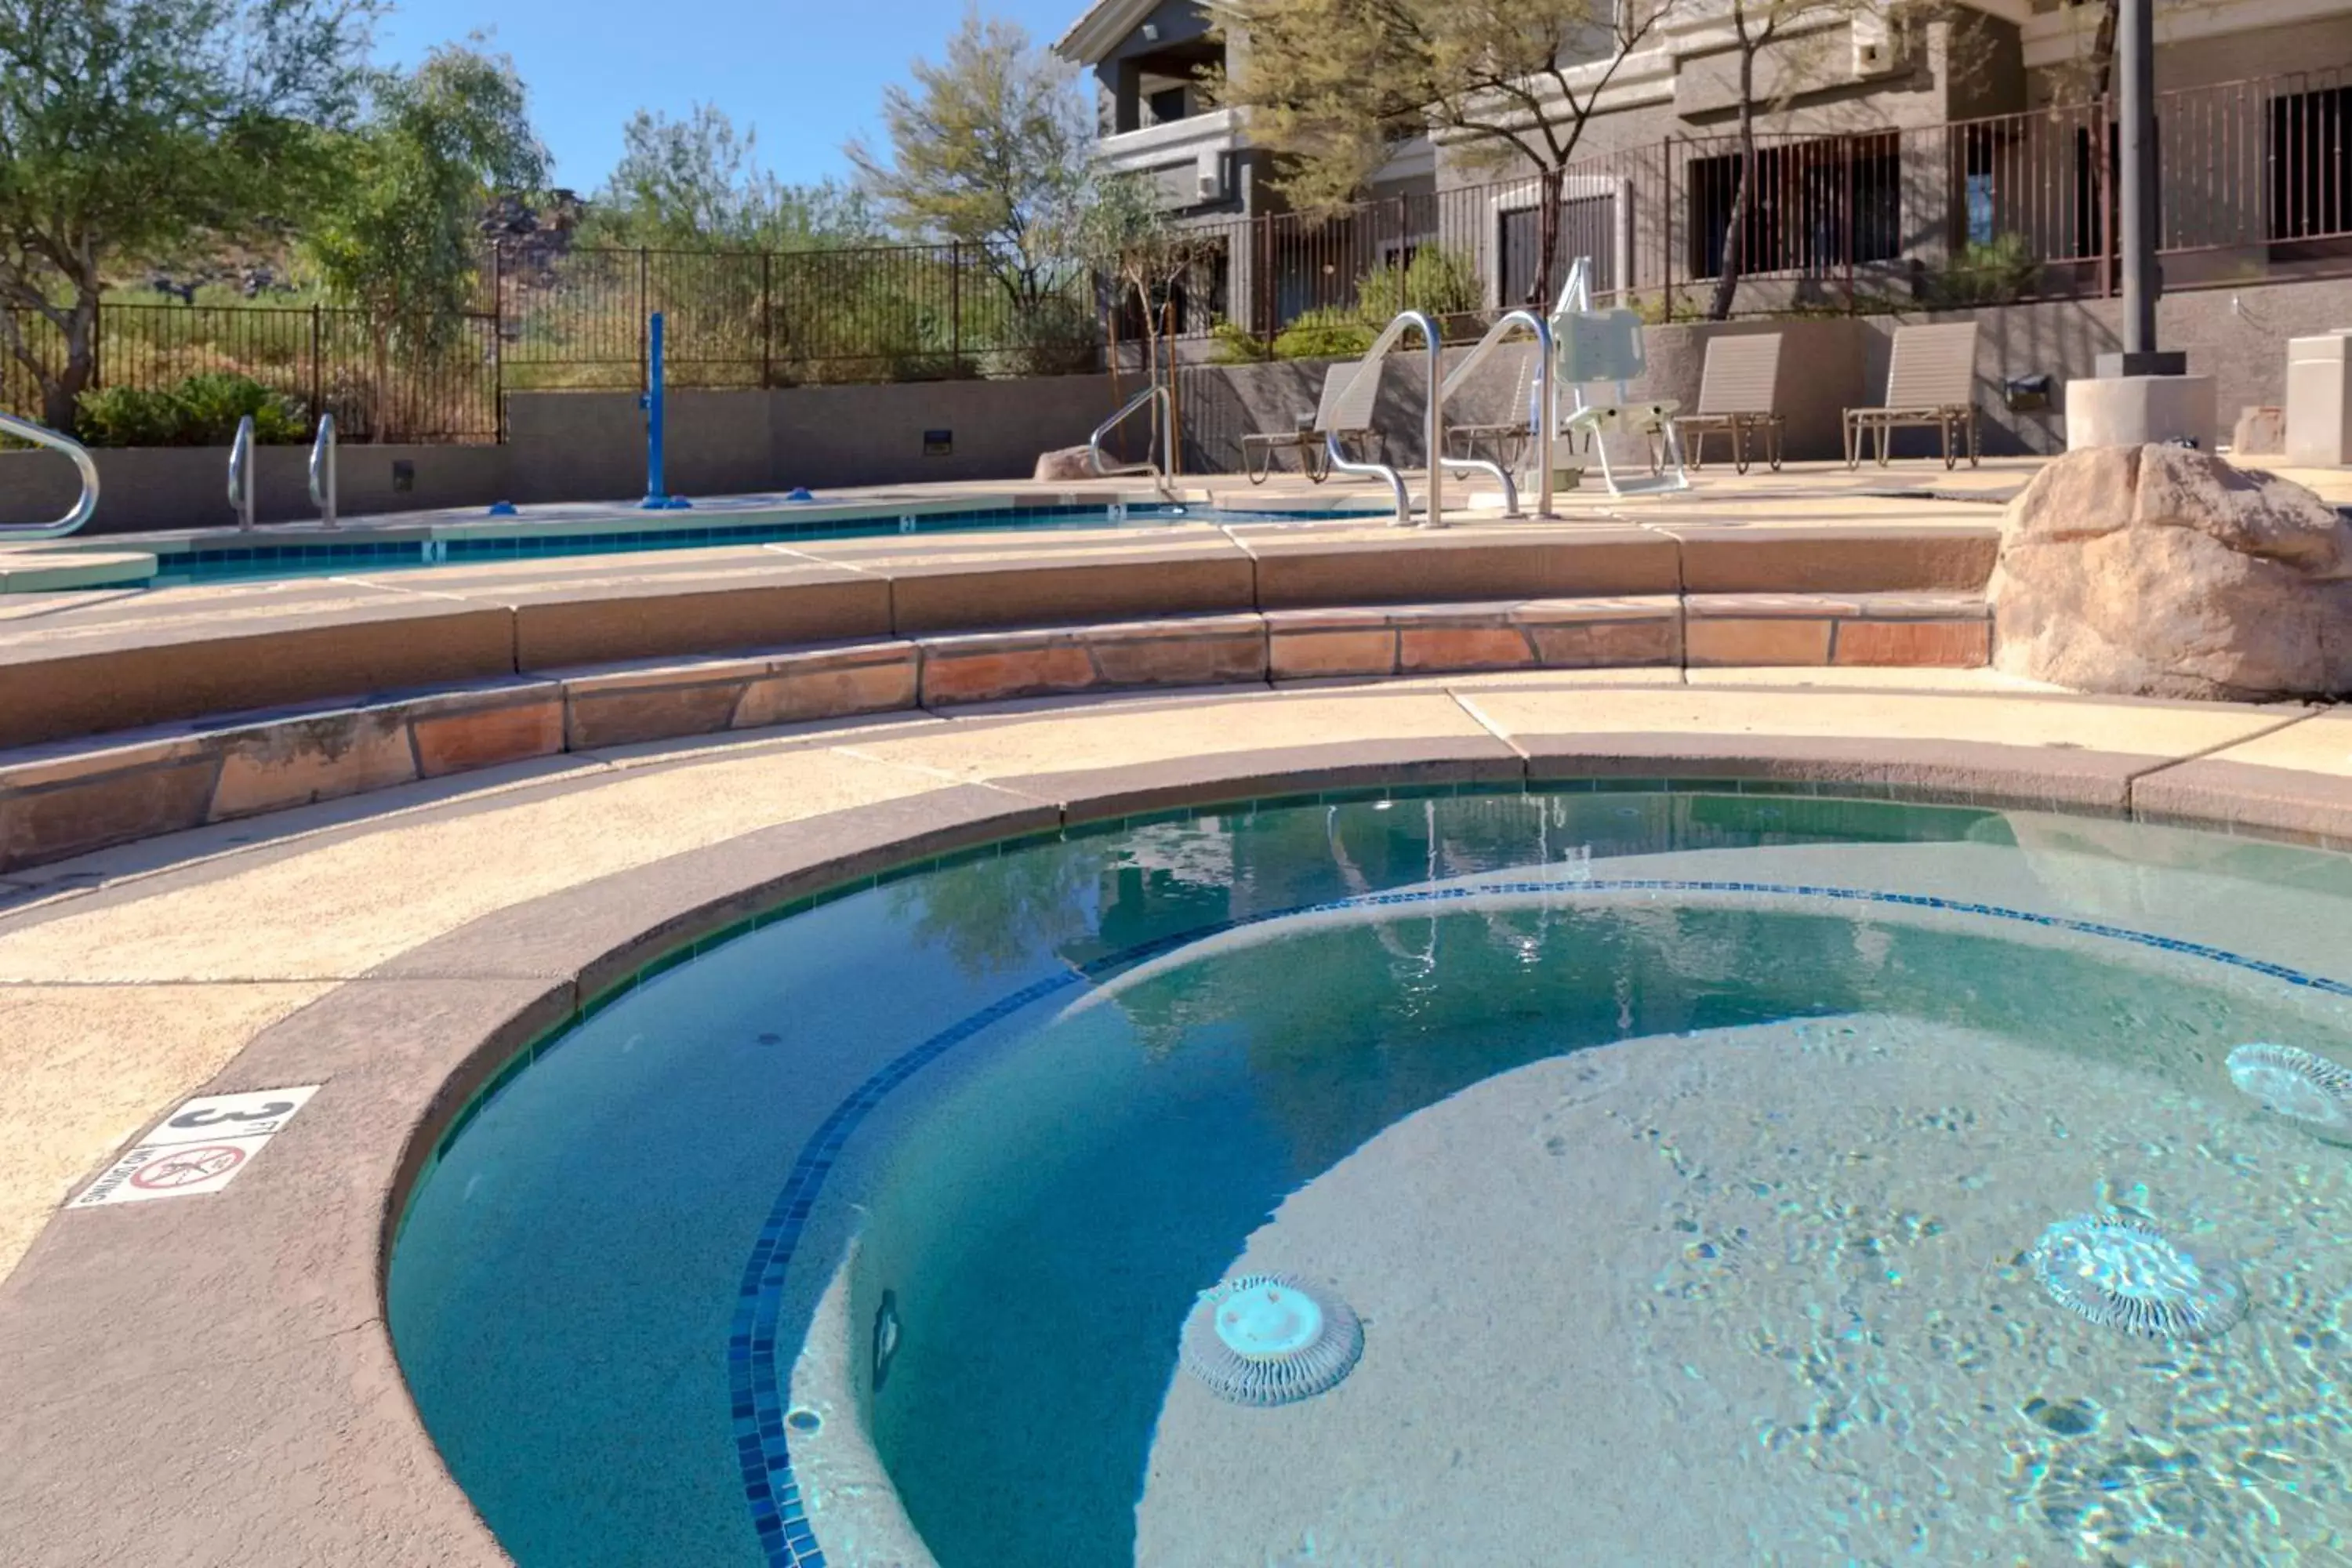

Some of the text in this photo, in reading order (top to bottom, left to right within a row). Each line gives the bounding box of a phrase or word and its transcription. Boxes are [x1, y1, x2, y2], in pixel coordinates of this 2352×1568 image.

[168, 1102, 295, 1128] 3
[80, 1149, 157, 1203] NO DIVING
